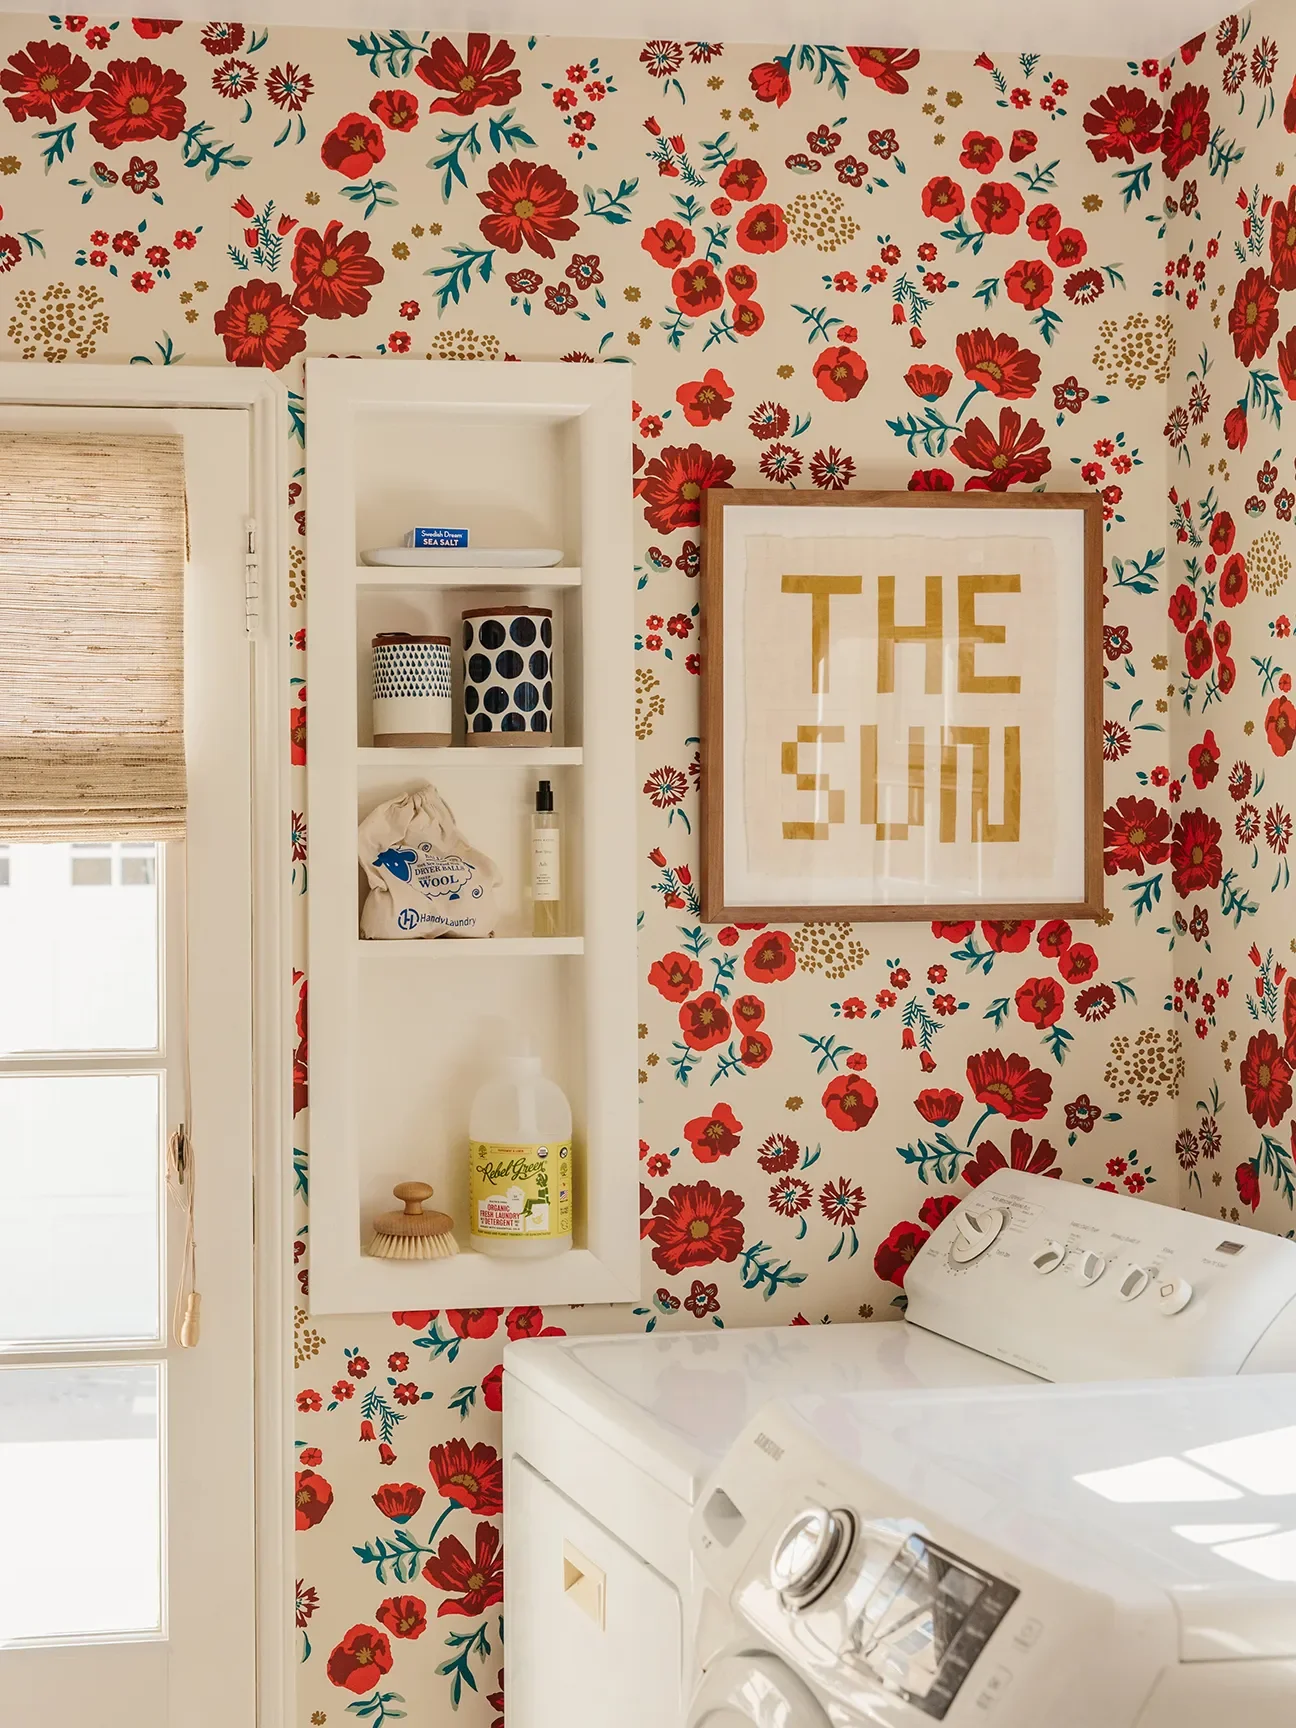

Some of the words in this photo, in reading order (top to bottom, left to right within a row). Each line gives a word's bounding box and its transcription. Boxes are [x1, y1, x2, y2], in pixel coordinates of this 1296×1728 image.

[421, 530, 443, 538] Swedish
[444, 531, 463, 539] Dream
[423, 538, 438, 546] SEA
[781, 574, 1021, 694] THE
[781, 725, 1020, 843] SUN
[415, 865, 441, 875] DRYER
[419, 874, 459, 888] WOOL
[476, 1160, 513, 1185] Rebel
[511, 1157, 546, 1181] Green
[487, 1203, 510, 1212] ORGANIC
[480, 1210, 494, 1218] FRESH
[495, 1211, 520, 1220] LAUNDRY
[485, 1217, 513, 1227] DETERGENT
